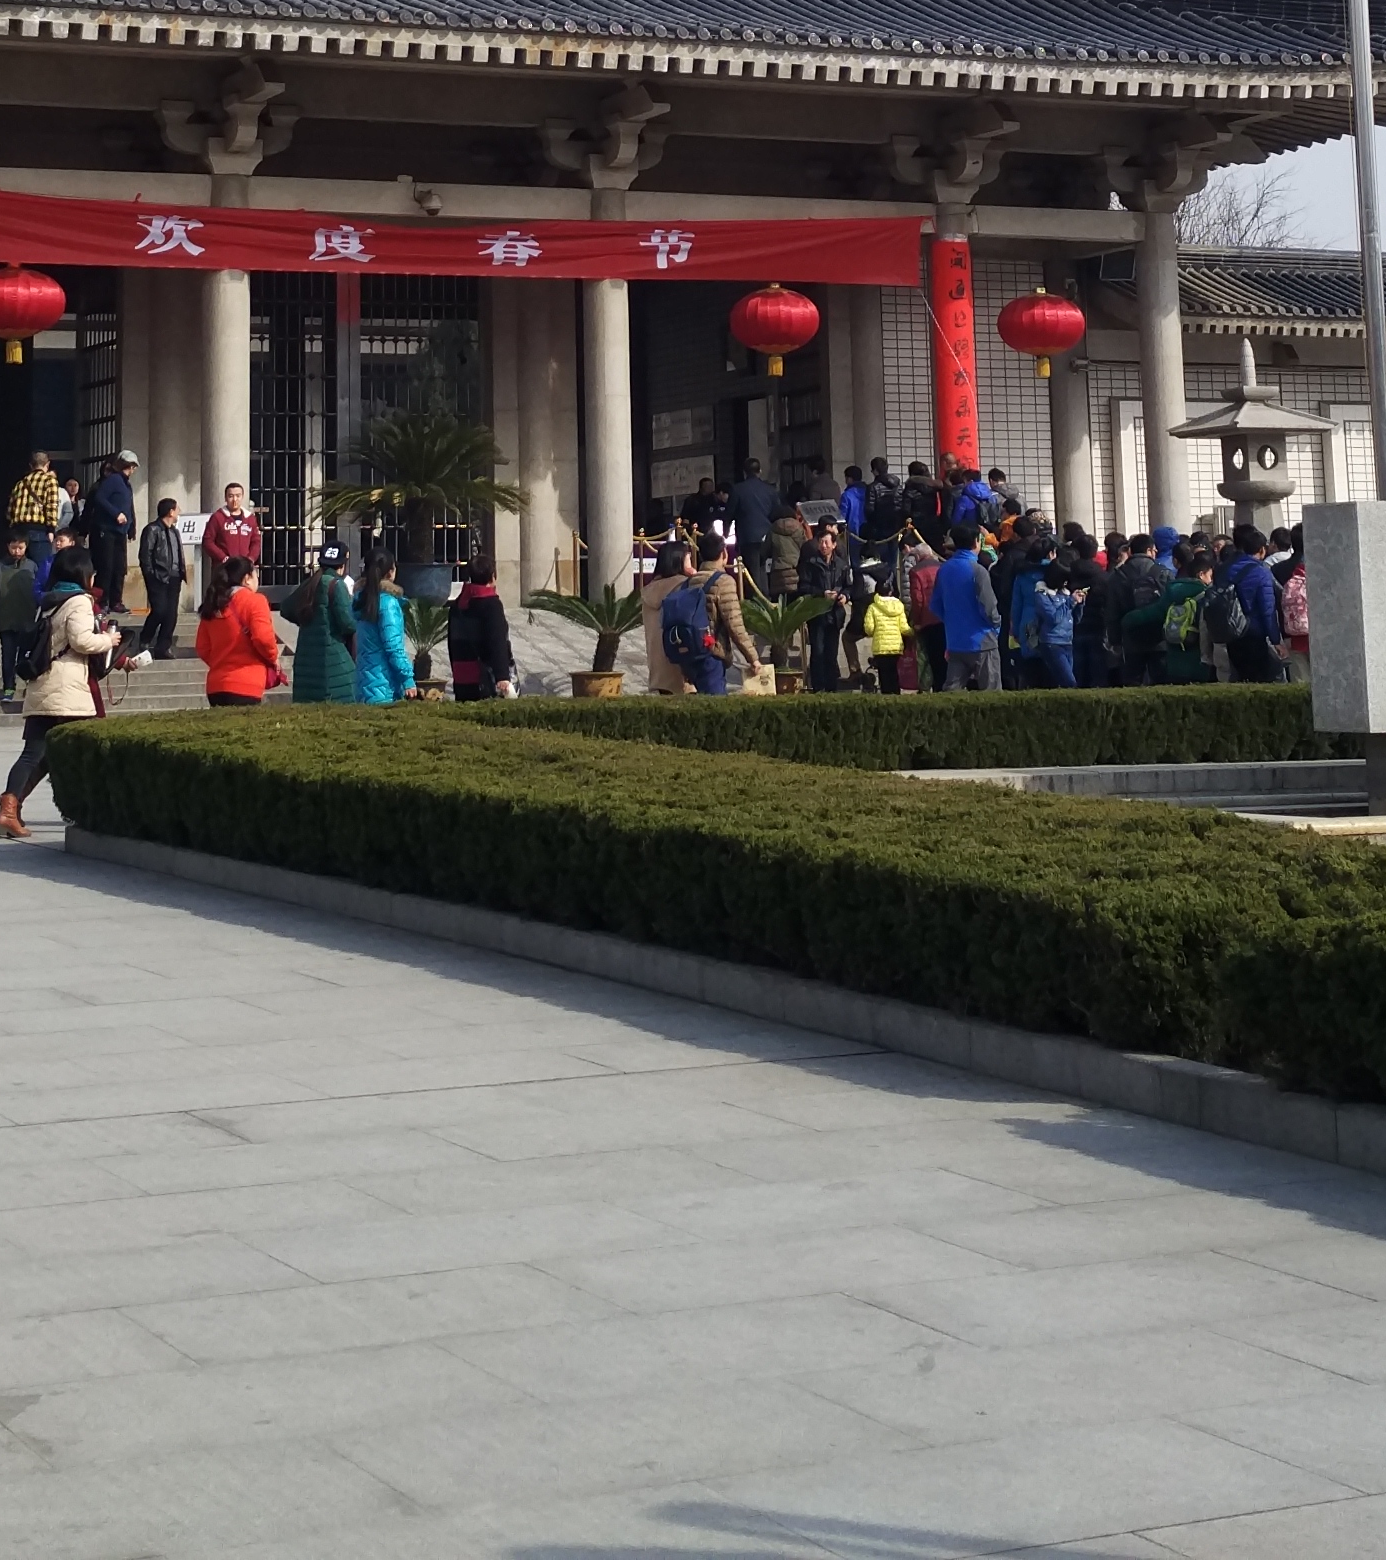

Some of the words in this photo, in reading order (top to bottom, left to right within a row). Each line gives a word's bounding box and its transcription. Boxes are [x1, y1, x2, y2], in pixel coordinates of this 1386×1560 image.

[134, 214, 696, 269] 欢度春节
[324, 547, 339, 559] 23
